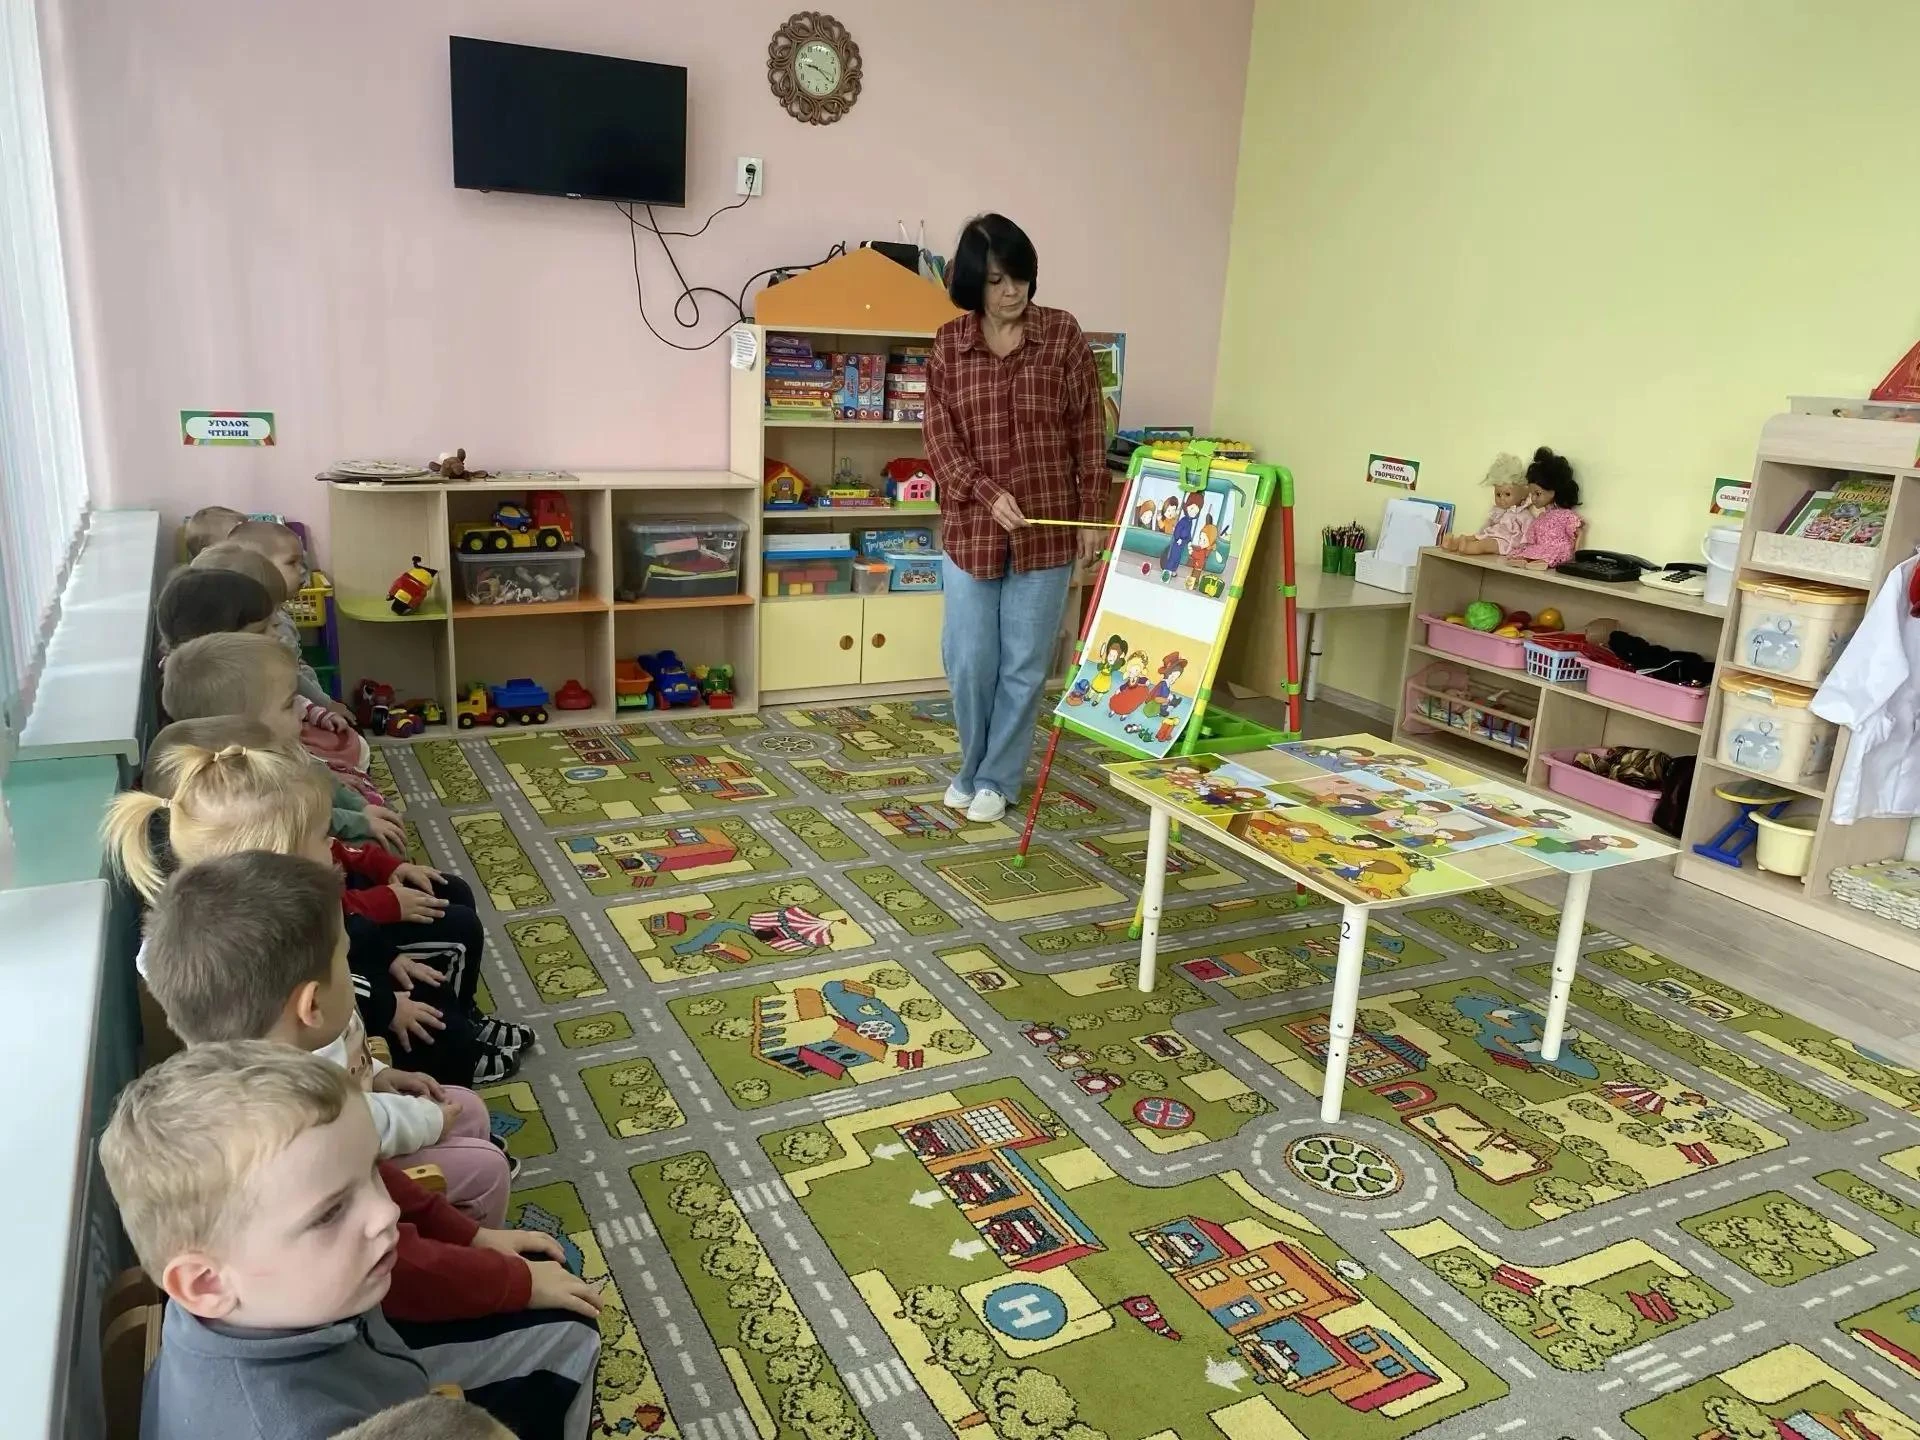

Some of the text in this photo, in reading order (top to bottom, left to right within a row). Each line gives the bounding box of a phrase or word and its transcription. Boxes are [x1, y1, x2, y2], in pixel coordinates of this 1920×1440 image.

[208, 420, 249, 428] УГОЛОК
[208, 429, 249, 437] ЧТЕНИЯ
[1381, 463, 1405, 473] УГОЛОК
[1374, 470, 1410, 482] ТВОРЧЕСТВА
[1836, 491, 1890, 503] ПОРОСЕ
[1341, 921, 1351, 939] 2
[998, 1293, 1052, 1329] H
